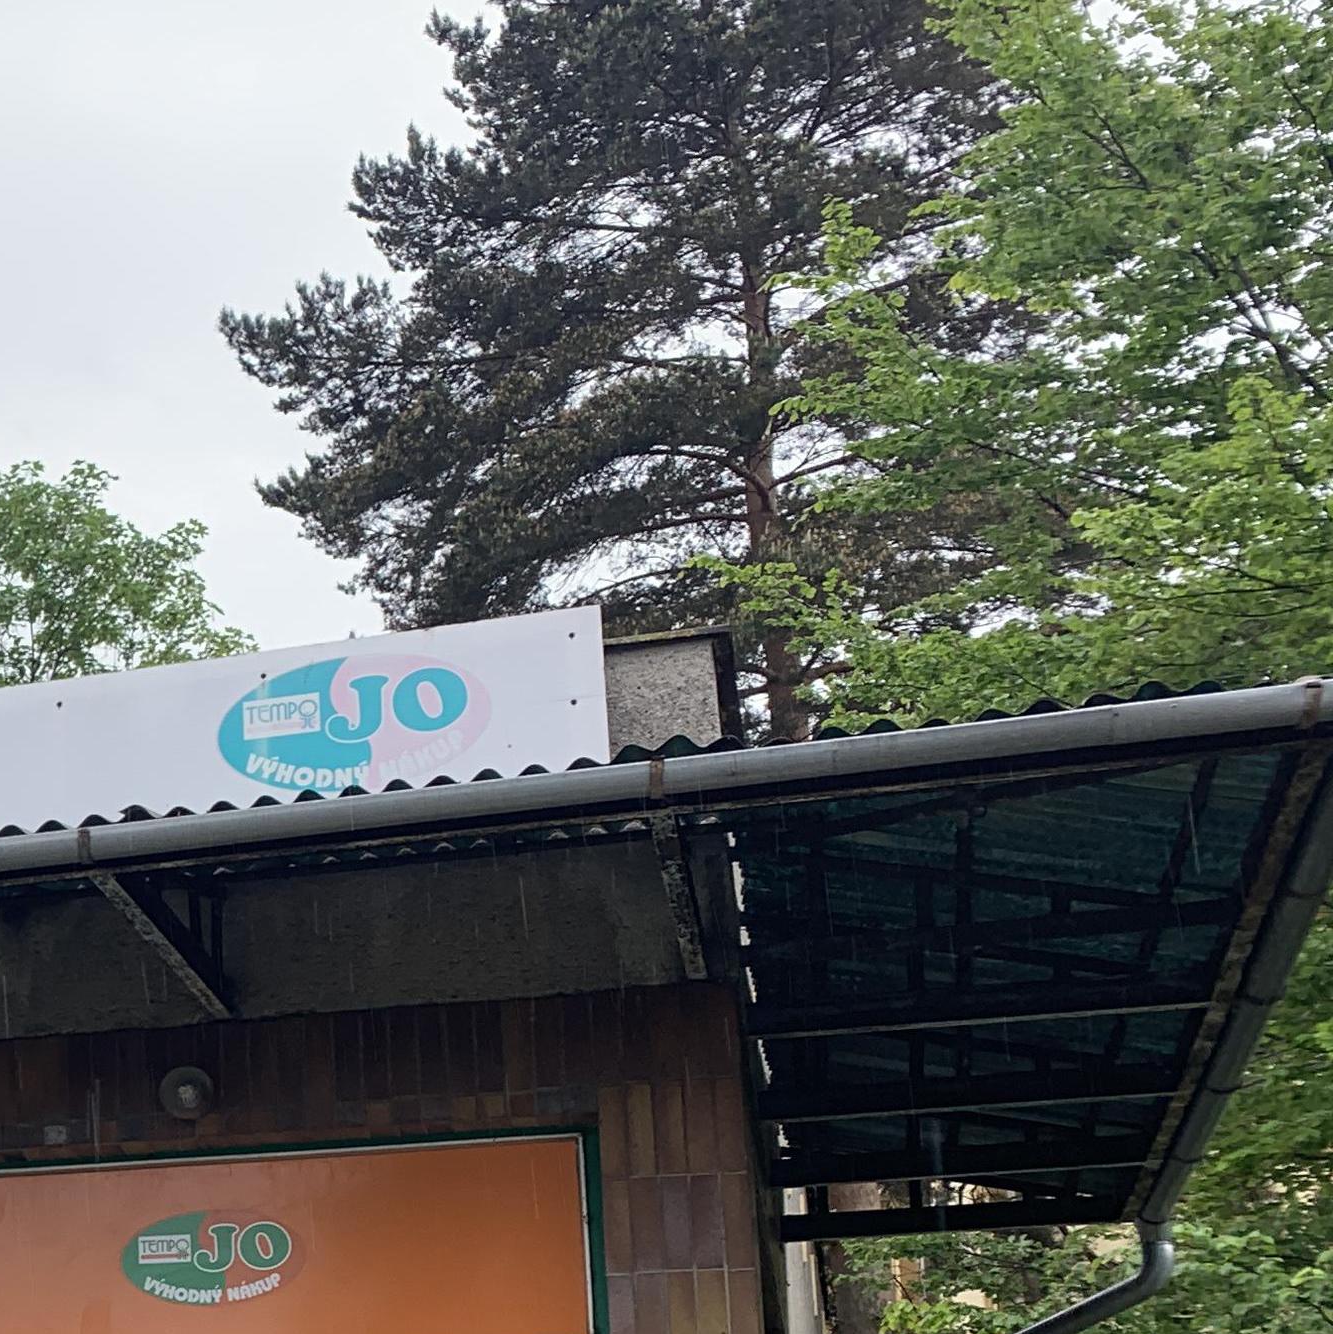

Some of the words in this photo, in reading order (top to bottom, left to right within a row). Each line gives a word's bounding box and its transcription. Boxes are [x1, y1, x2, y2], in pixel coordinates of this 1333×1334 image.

[245, 698, 318, 727] TEMPO
[326, 666, 469, 743] JO
[246, 752, 370, 790] VÝHODNÝ
[140, 1238, 190, 1254] TEMPO
[194, 1221, 292, 1273] JO
[144, 1276, 223, 1304] VÝHODNÝ
[227, 1273, 281, 1302] NÁKUP
